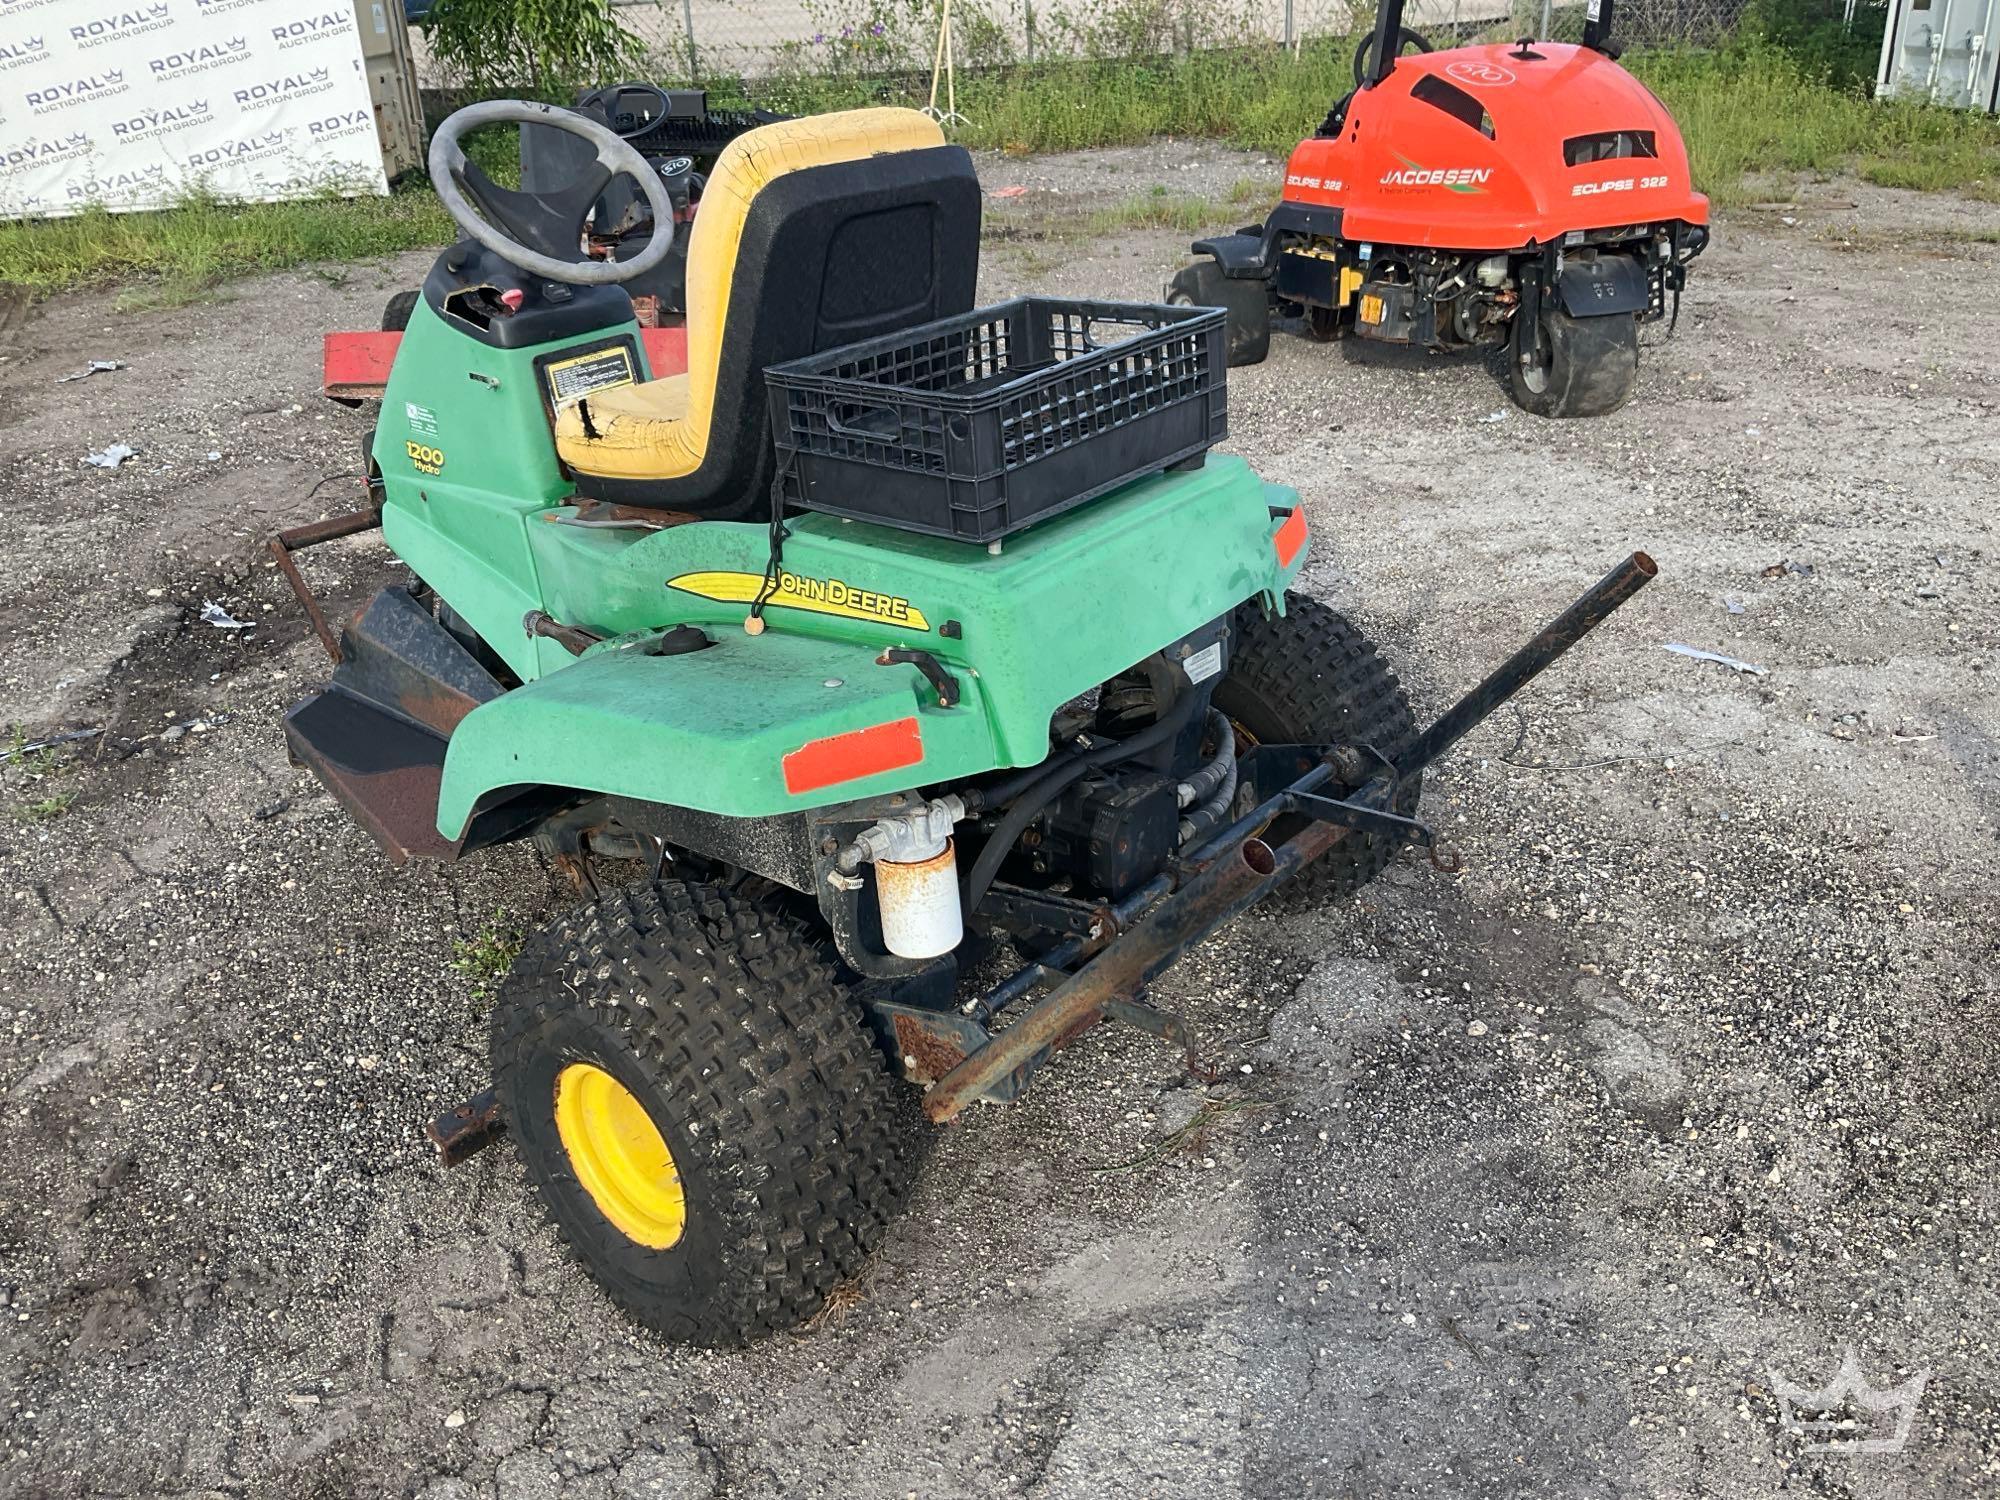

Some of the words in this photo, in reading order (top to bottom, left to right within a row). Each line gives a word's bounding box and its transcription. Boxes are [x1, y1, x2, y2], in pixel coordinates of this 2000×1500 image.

[0, 0, 45, 17] UCTION
[70, 9, 150, 40] ROYAL
[77, 29, 132, 50] AUCTION
[133, 18, 175, 36] GROUP
[271, 11, 347, 41] ROYAL
[278, 30, 330, 51] AUCTION
[8, 51, 51, 68] GROUP
[149, 44, 227, 73] ROYAL
[156, 62, 210, 83] AUCTION
[210, 51, 252, 69] GROUP
[26, 77, 105, 107] ROYAL
[33, 96, 86, 116] AUCTION
[87, 84, 129, 101] GROUP
[233, 74, 311, 104] ROYAL
[240, 92, 292, 113] AUCTION
[294, 81, 334, 99] GROUP
[112, 107, 190, 136] ROYAL
[119, 125, 172, 146] AUCTION
[172, 114, 214, 131] GROUP
[308, 111, 368, 135] ROYA
[315, 126, 364, 144] AUCTION
[51, 146, 92, 163] GROUP
[188, 138, 265, 168] ROYAL
[247, 146, 288, 163] GROUP
[66, 171, 145, 199] ROYAL
[1287, 175, 1320, 188] ECLIPSE
[1323, 179, 1342, 191] 322
[1380, 169, 1489, 185] JACOBSEN
[1572, 179, 1634, 196] ECLIPSE
[1641, 176, 1668, 189] 322
[406, 441, 445, 466] 1200
[414, 459, 440, 475] Hydro
[827, 579, 908, 619] DEERE
